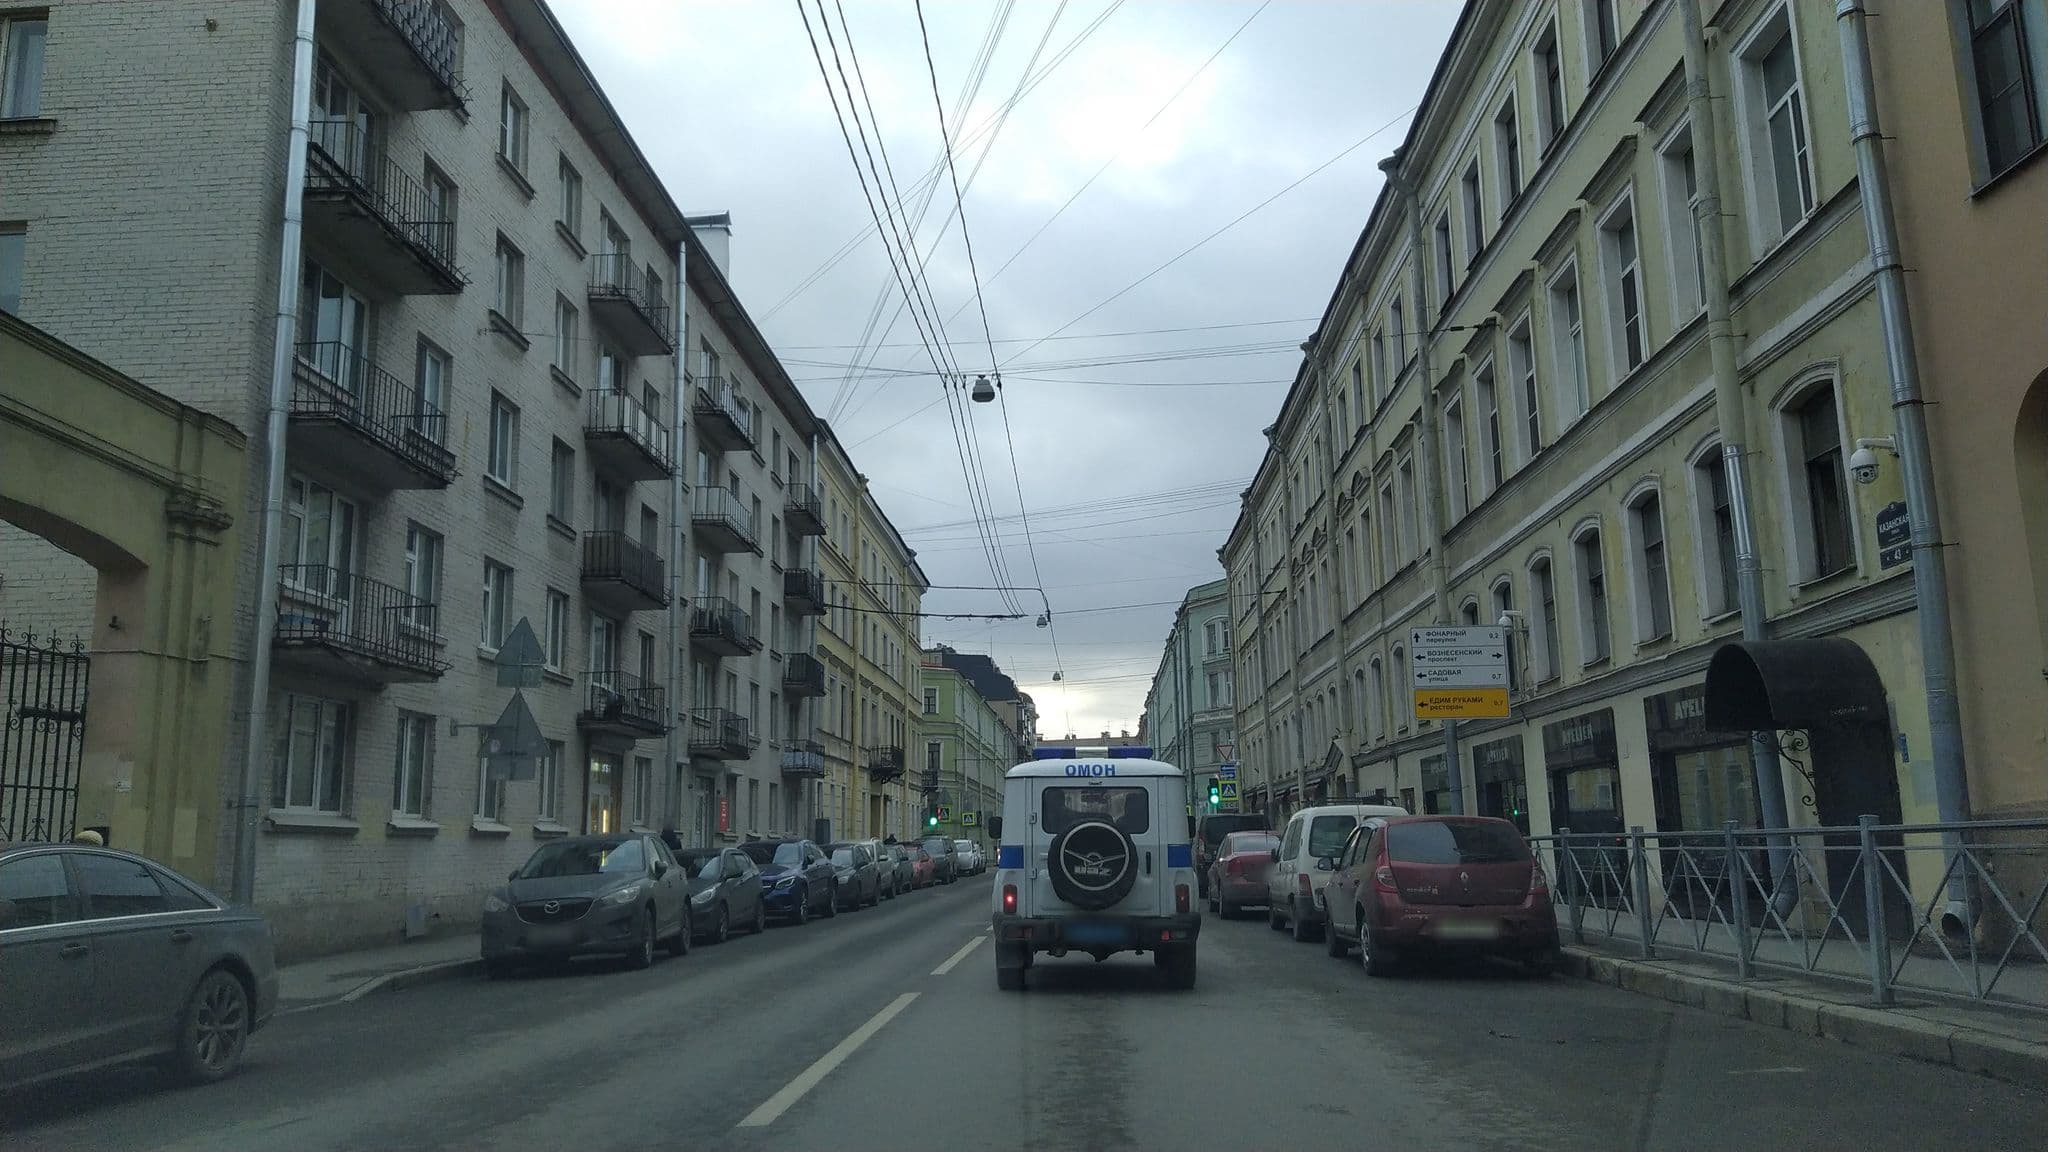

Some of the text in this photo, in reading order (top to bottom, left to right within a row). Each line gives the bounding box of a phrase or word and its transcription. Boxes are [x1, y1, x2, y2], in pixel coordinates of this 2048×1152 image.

[1429, 697, 1451, 705] ЕДИМ
[1451, 696, 1483, 704] РУКАМИ
[1065, 764, 1116, 777] ОМОН
